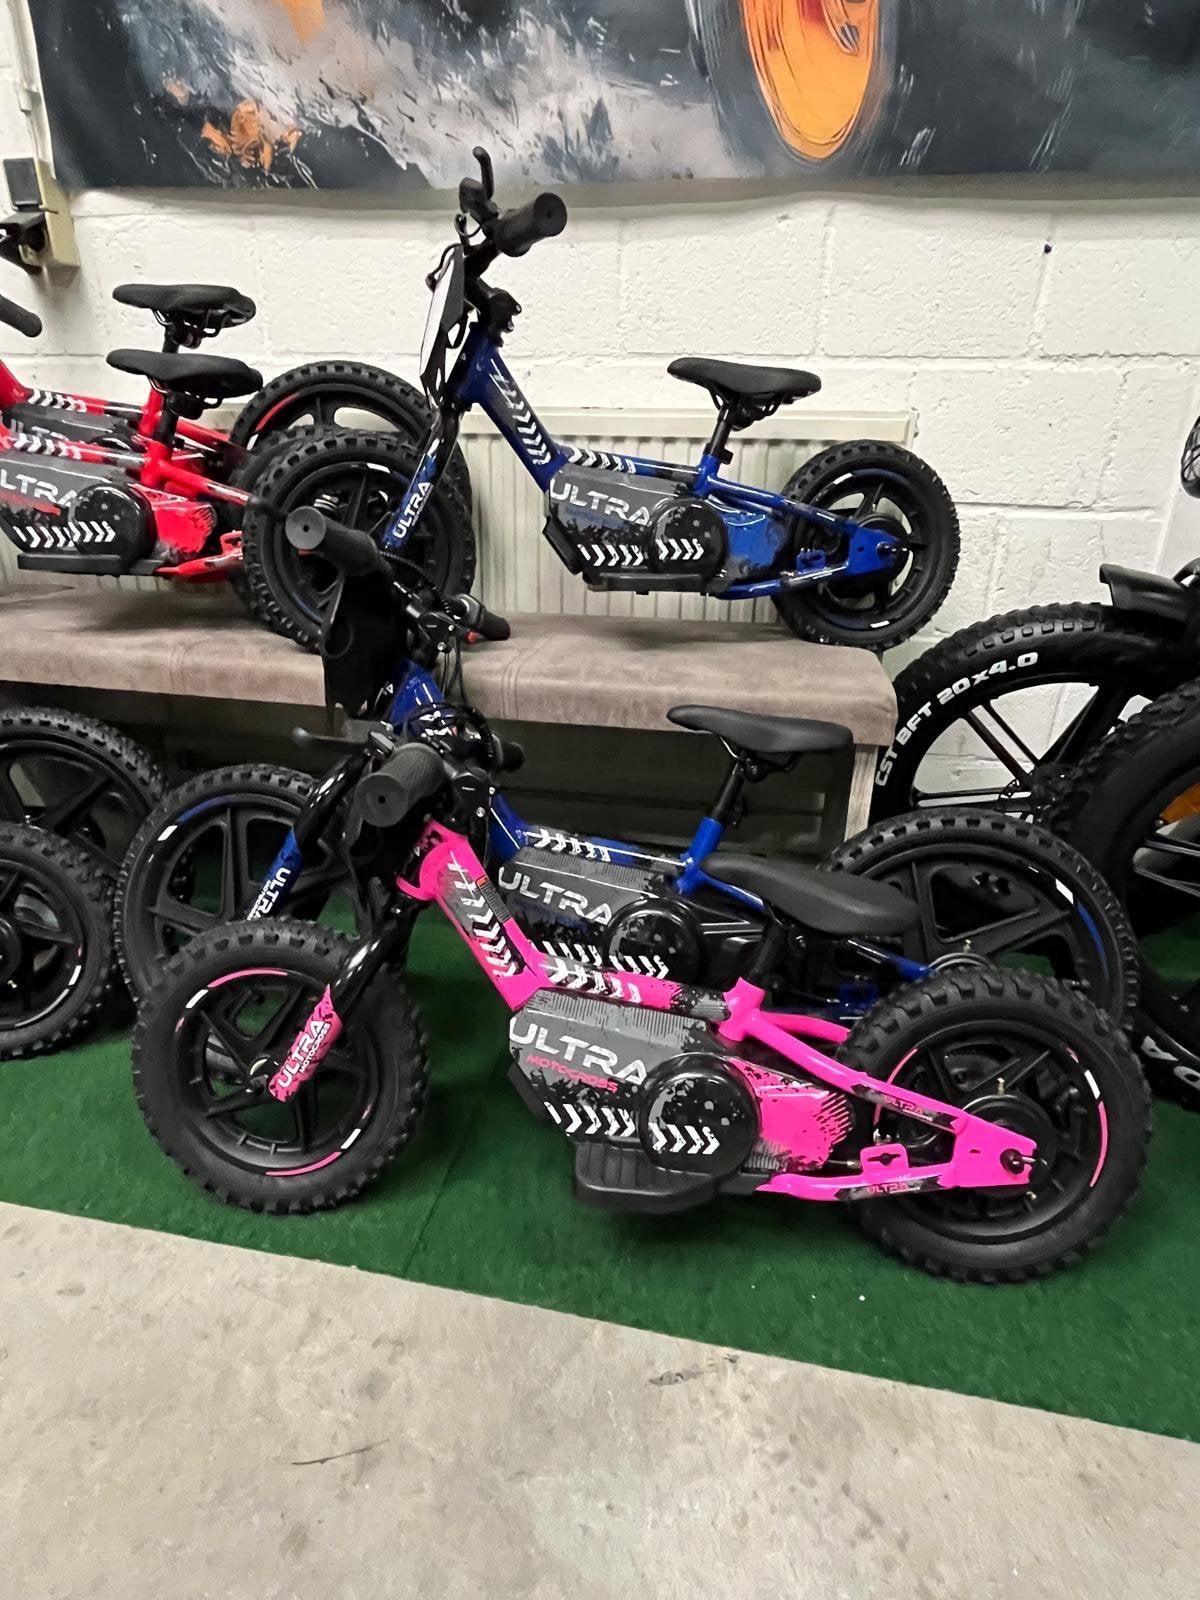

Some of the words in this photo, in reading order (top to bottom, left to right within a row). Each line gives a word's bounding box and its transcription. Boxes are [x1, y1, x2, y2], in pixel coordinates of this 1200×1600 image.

[0, 468, 77, 508] LTRA
[392, 482, 431, 539] ULTRA
[549, 478, 650, 526] ULTRA
[875, 744, 898, 786] CST
[895, 701, 932, 745] BFT
[936, 652, 1038, 705] 20x4.0
[498, 866, 612, 925] ULTRA
[277, 1020, 325, 1088] ULTRA
[509, 1016, 647, 1085] ULTRA
[884, 1095, 923, 1115] ULTRA
[866, 1181, 909, 1194] ULTRA
